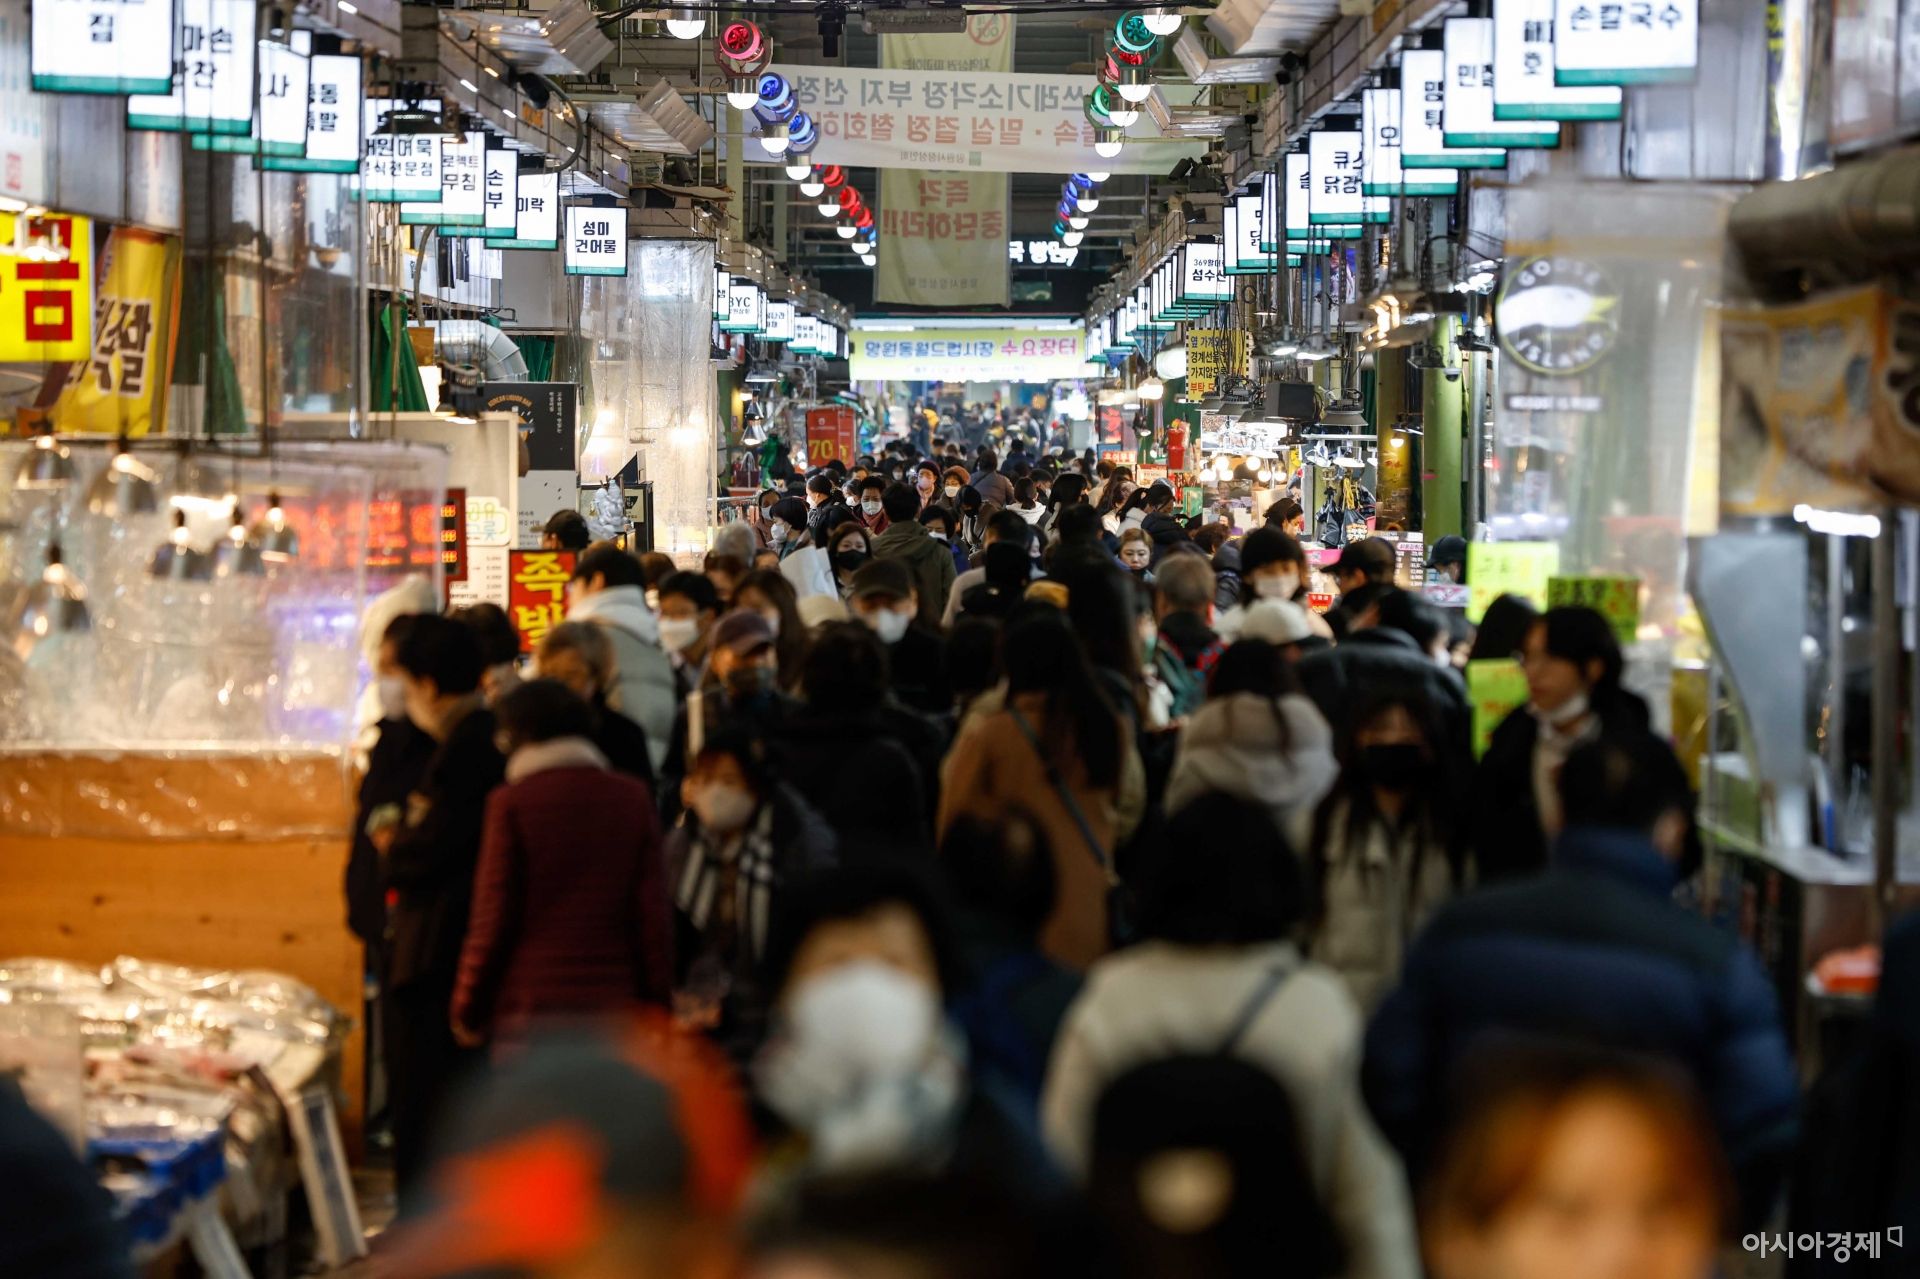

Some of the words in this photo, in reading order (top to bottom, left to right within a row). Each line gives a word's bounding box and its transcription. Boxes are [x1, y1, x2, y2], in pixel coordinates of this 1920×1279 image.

[1570, 4, 1681, 30] 손칼국수
[1325, 176, 1362, 194] 닭강
[583, 221, 609, 236] 성미
[575, 239, 616, 254] 건어물
[1001, 338, 1077, 357] 수요장터
